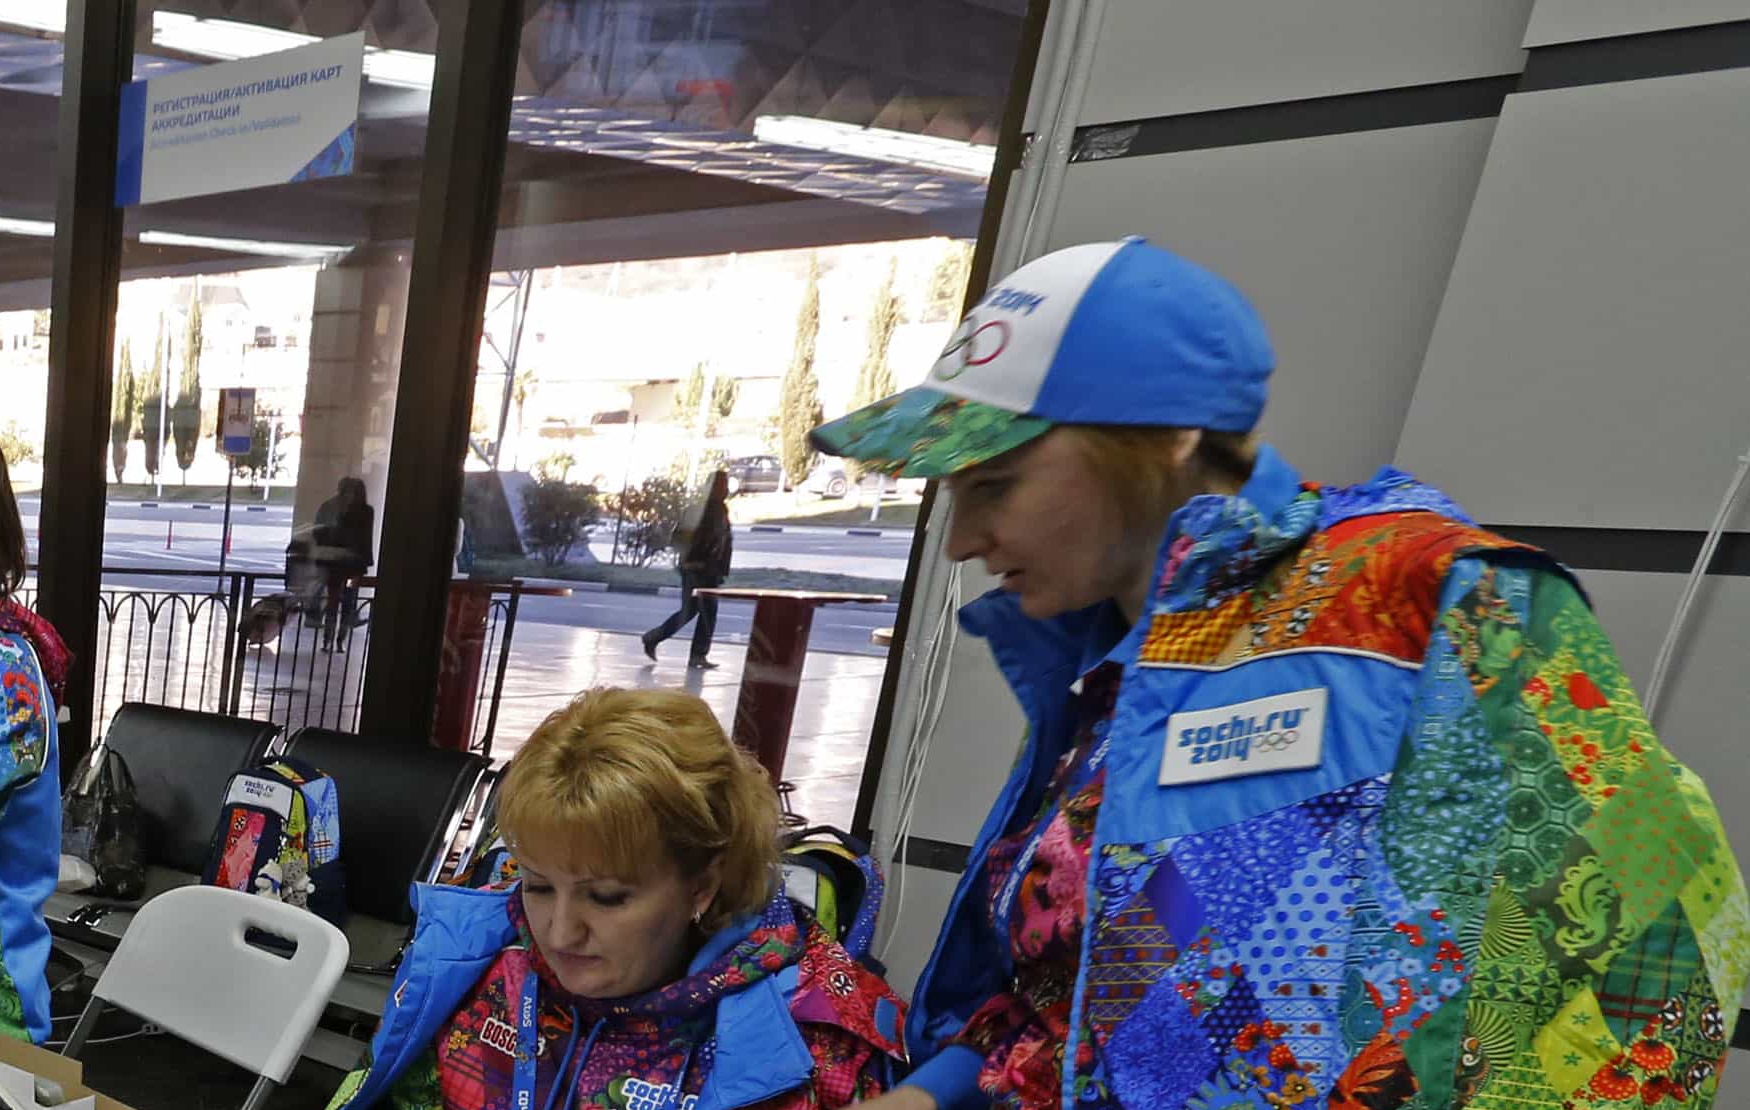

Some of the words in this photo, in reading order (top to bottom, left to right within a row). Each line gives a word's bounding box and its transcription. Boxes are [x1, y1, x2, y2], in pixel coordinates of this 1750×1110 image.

[153, 71, 307, 114] РЕГИСТРАЦИЯ/АКТИВАЦИЯ
[310, 65, 343, 84] КАРТ
[152, 105, 240, 132] АККРЕДИТАЦИИ
[1178, 709, 1303, 748] sochi.ru
[1190, 736, 1248, 765] 2014
[481, 1018, 517, 1053] BOSC
